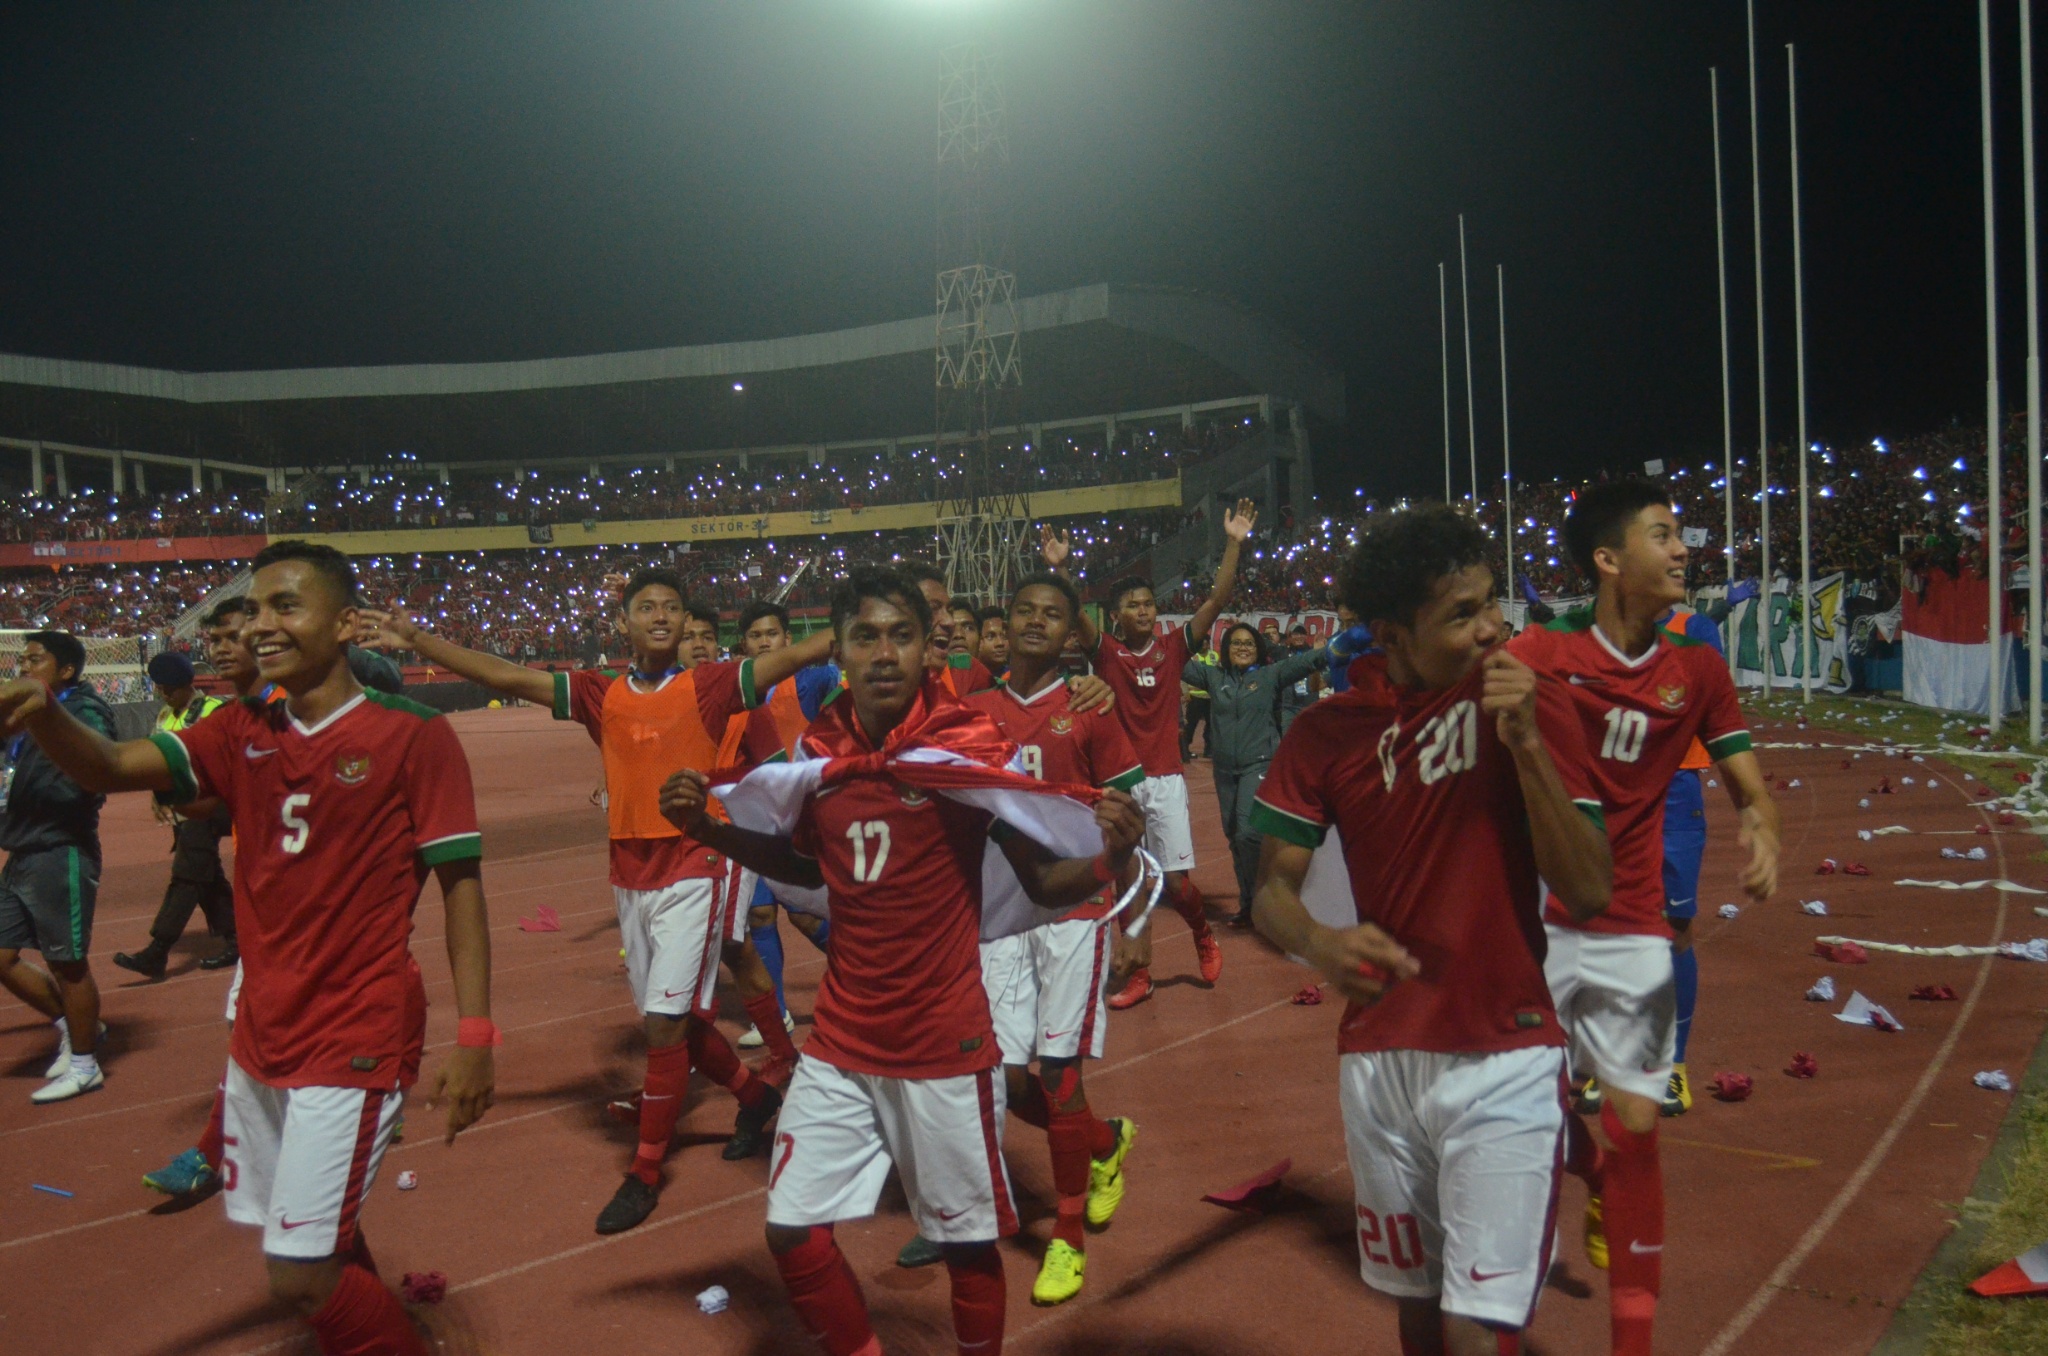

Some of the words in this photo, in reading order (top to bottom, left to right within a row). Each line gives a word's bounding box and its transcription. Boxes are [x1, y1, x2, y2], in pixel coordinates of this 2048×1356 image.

[1134, 667, 1156, 687] 16
[1021, 744, 1043, 781] 9
[1414, 700, 1477, 786] 20
[1601, 706, 1648, 763] 10
[281, 793, 311, 854] 5
[846, 820, 892, 882] 17
[1357, 1203, 1425, 1270] 20
